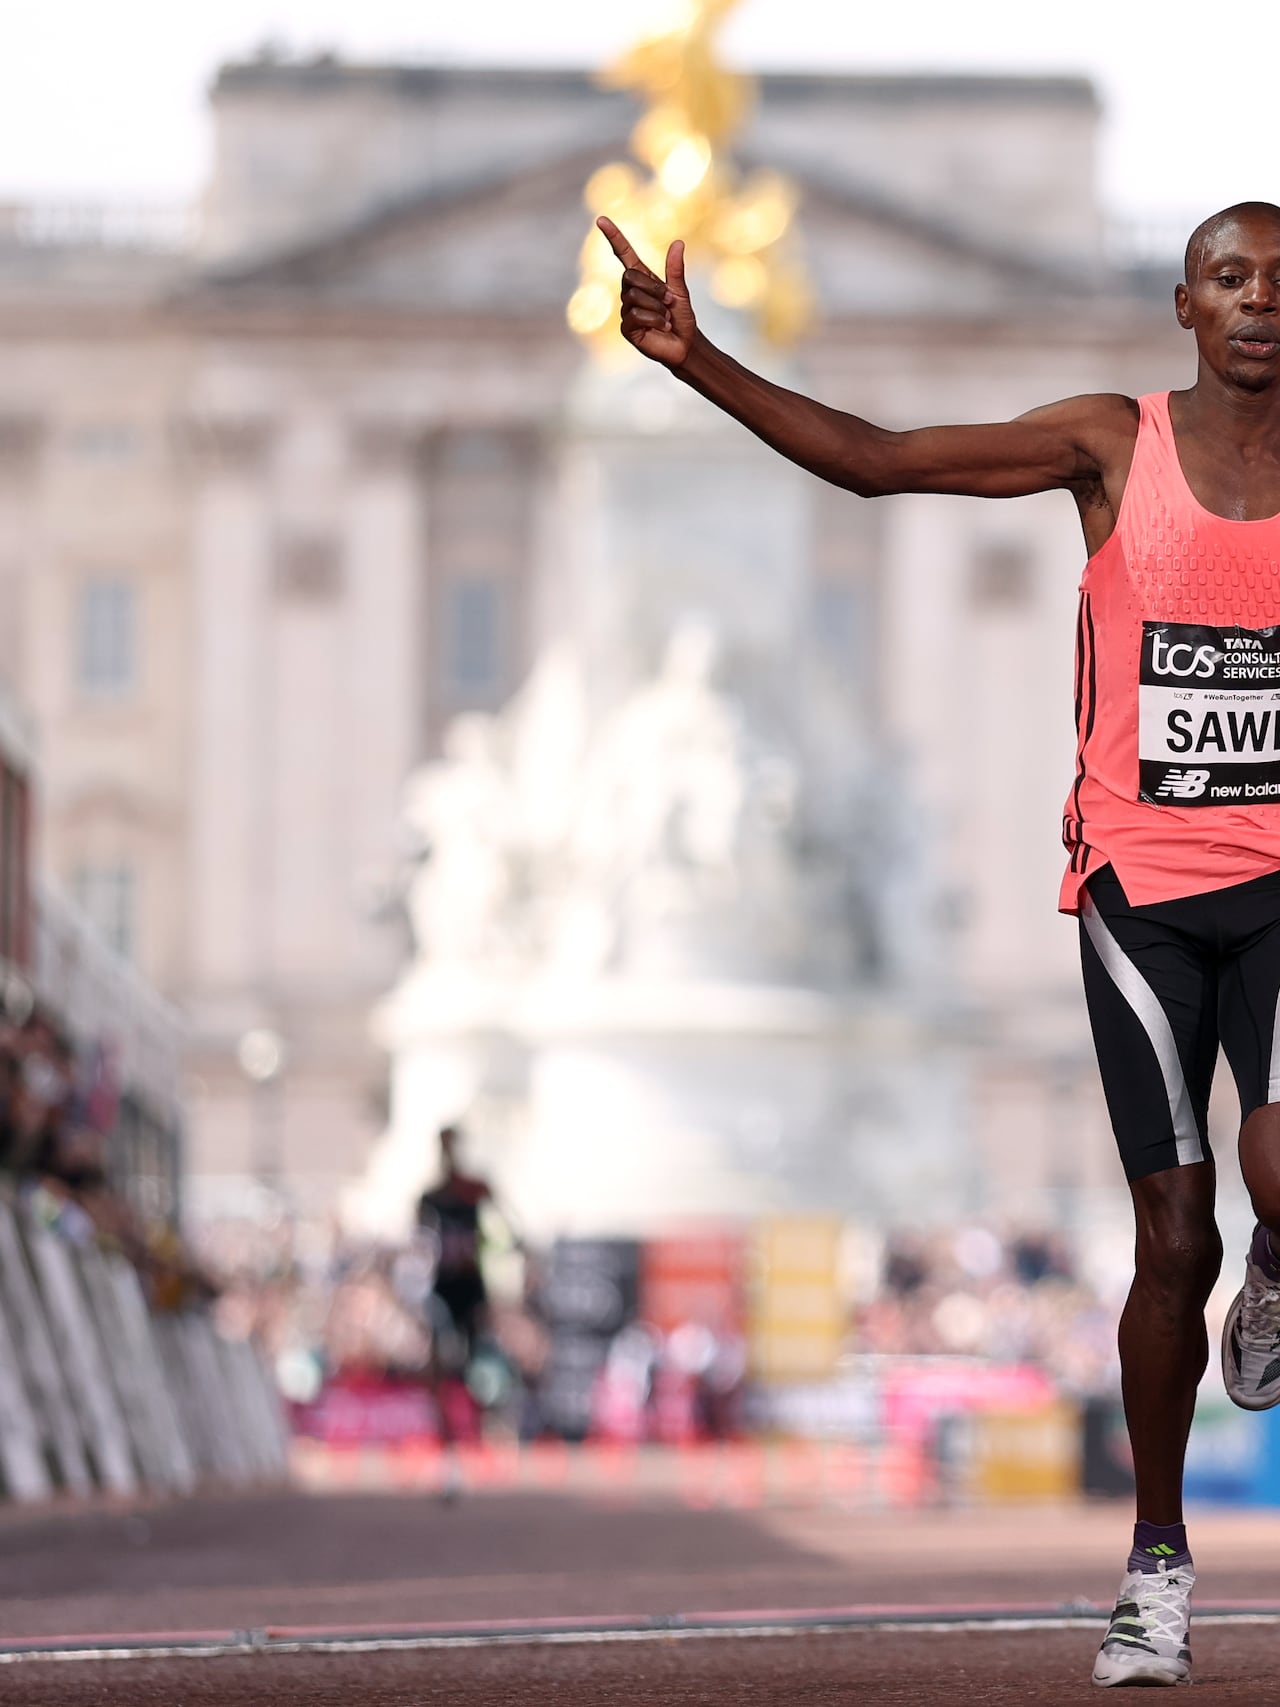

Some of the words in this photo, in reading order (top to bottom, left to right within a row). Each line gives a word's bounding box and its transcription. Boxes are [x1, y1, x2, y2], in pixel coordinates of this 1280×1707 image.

[1223, 638, 1263, 650] TATA
[1152, 633, 1215, 678] tcs
[1204, 694, 1264, 702] #WeRunTogether
[1211, 785, 1243, 798] new
